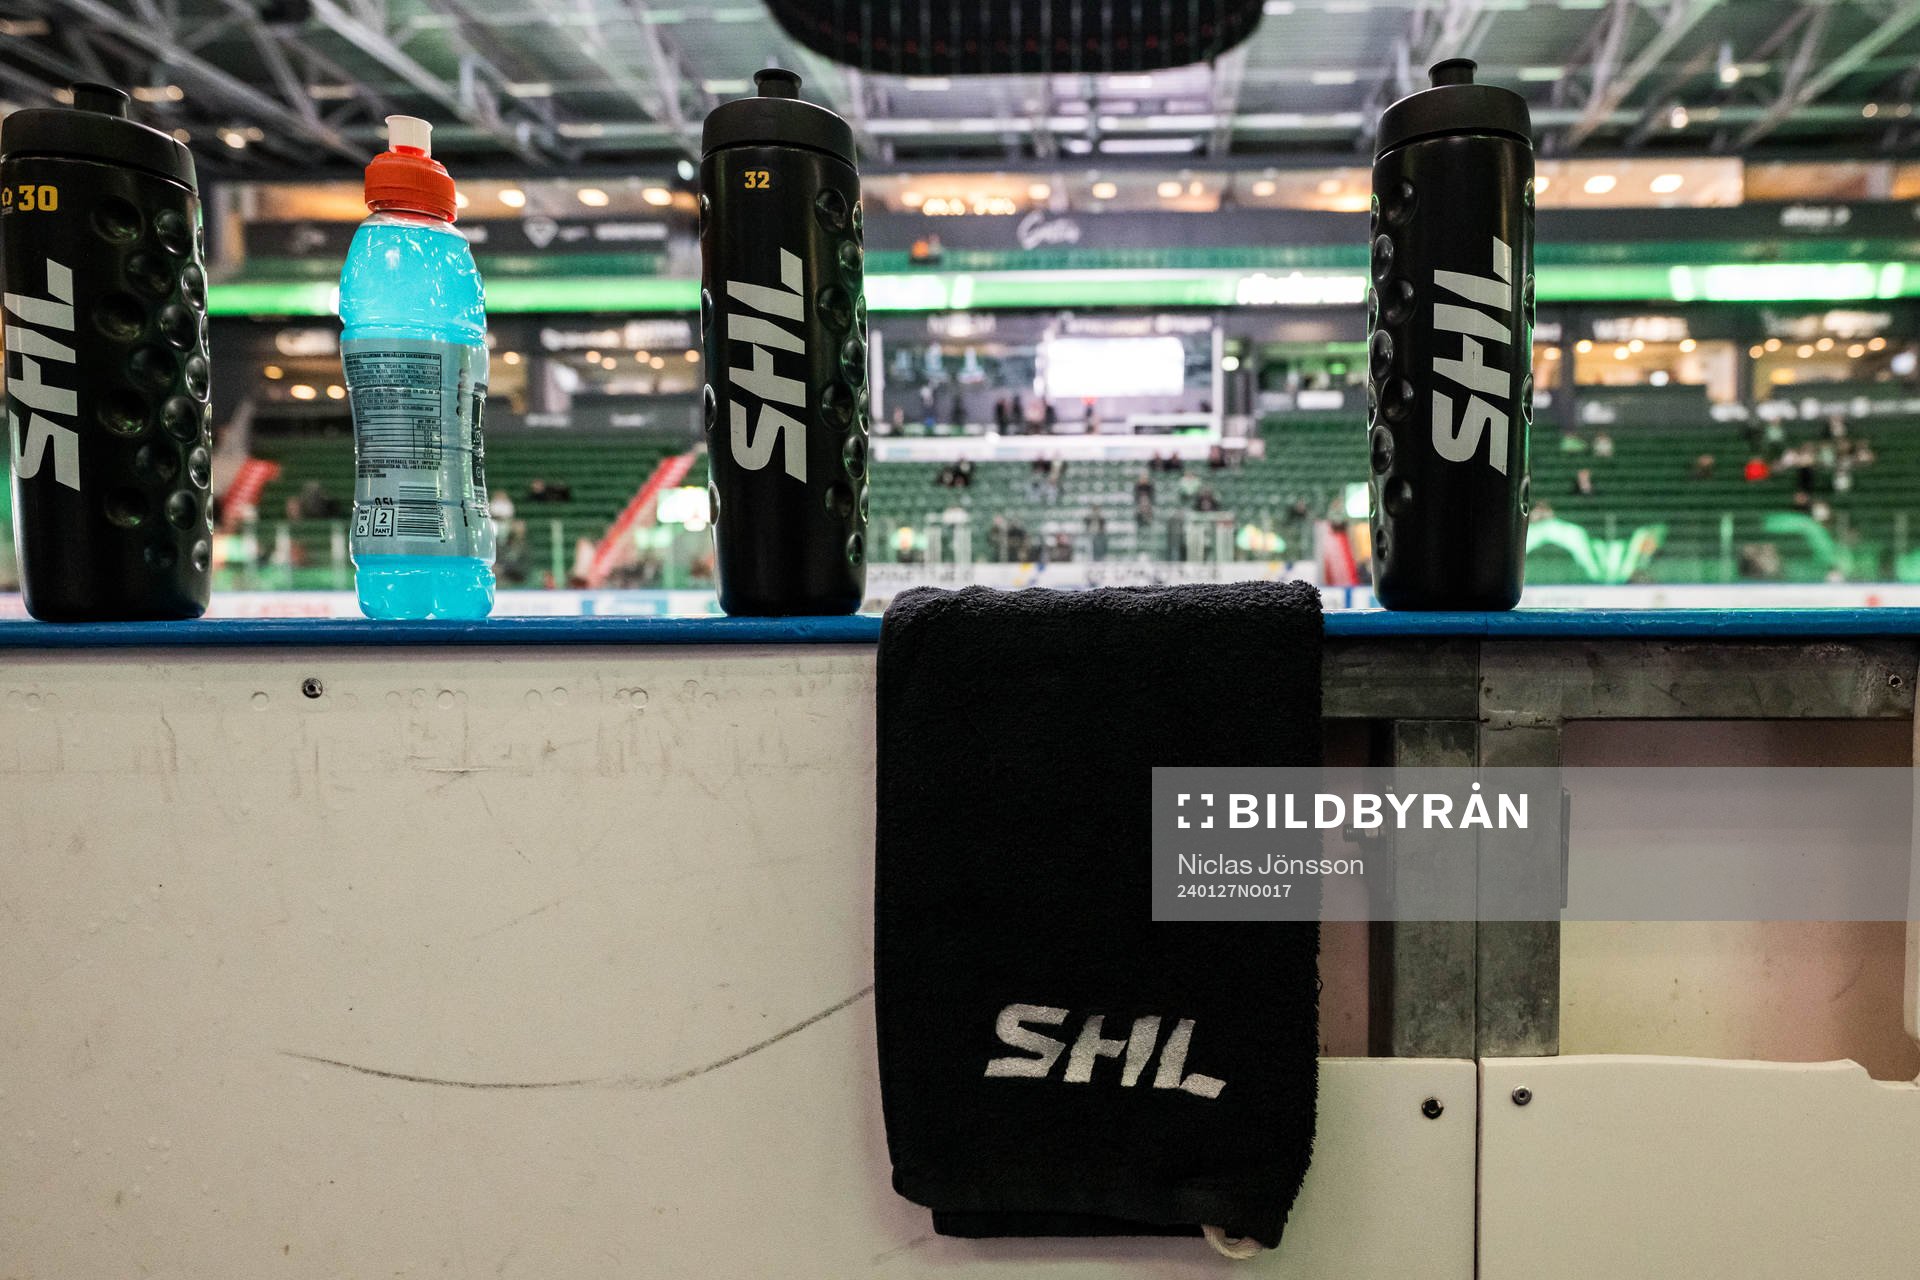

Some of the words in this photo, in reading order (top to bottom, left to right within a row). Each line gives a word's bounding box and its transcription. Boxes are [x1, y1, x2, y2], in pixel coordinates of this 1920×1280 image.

[18, 184, 58, 211] 30
[744, 170, 770, 189] 32
[4, 257, 81, 492] SHL
[726, 247, 807, 484] SHL
[1431, 236, 1512, 476] SHL
[379, 512, 387, 524] 2
[983, 1003, 1227, 1099] SHL
